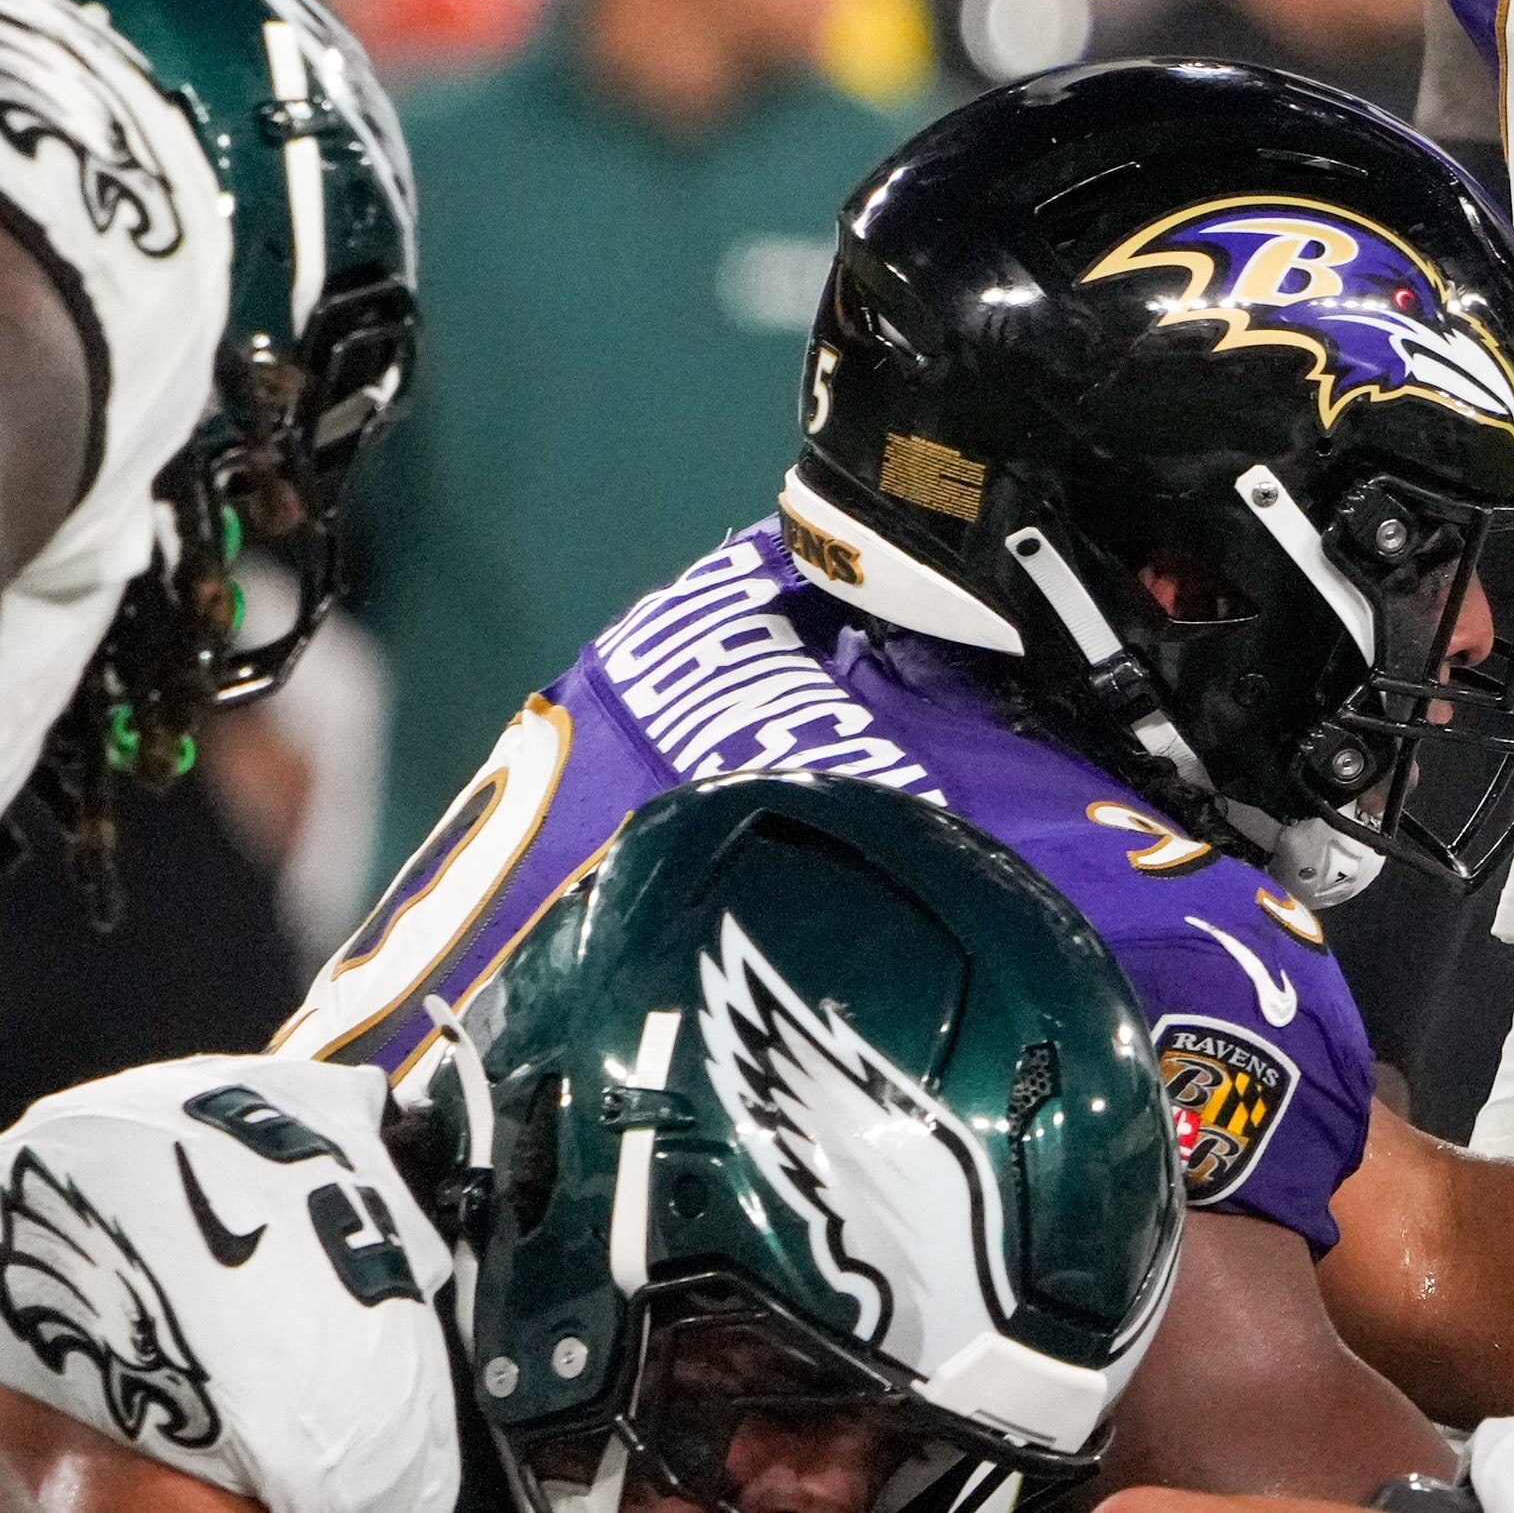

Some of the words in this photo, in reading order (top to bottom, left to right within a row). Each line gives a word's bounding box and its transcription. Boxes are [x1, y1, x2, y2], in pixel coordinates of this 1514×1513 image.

[1200, 217, 1359, 308] B
[807, 347, 838, 435] 5
[1171, 1032, 1281, 1088] RAVENS
